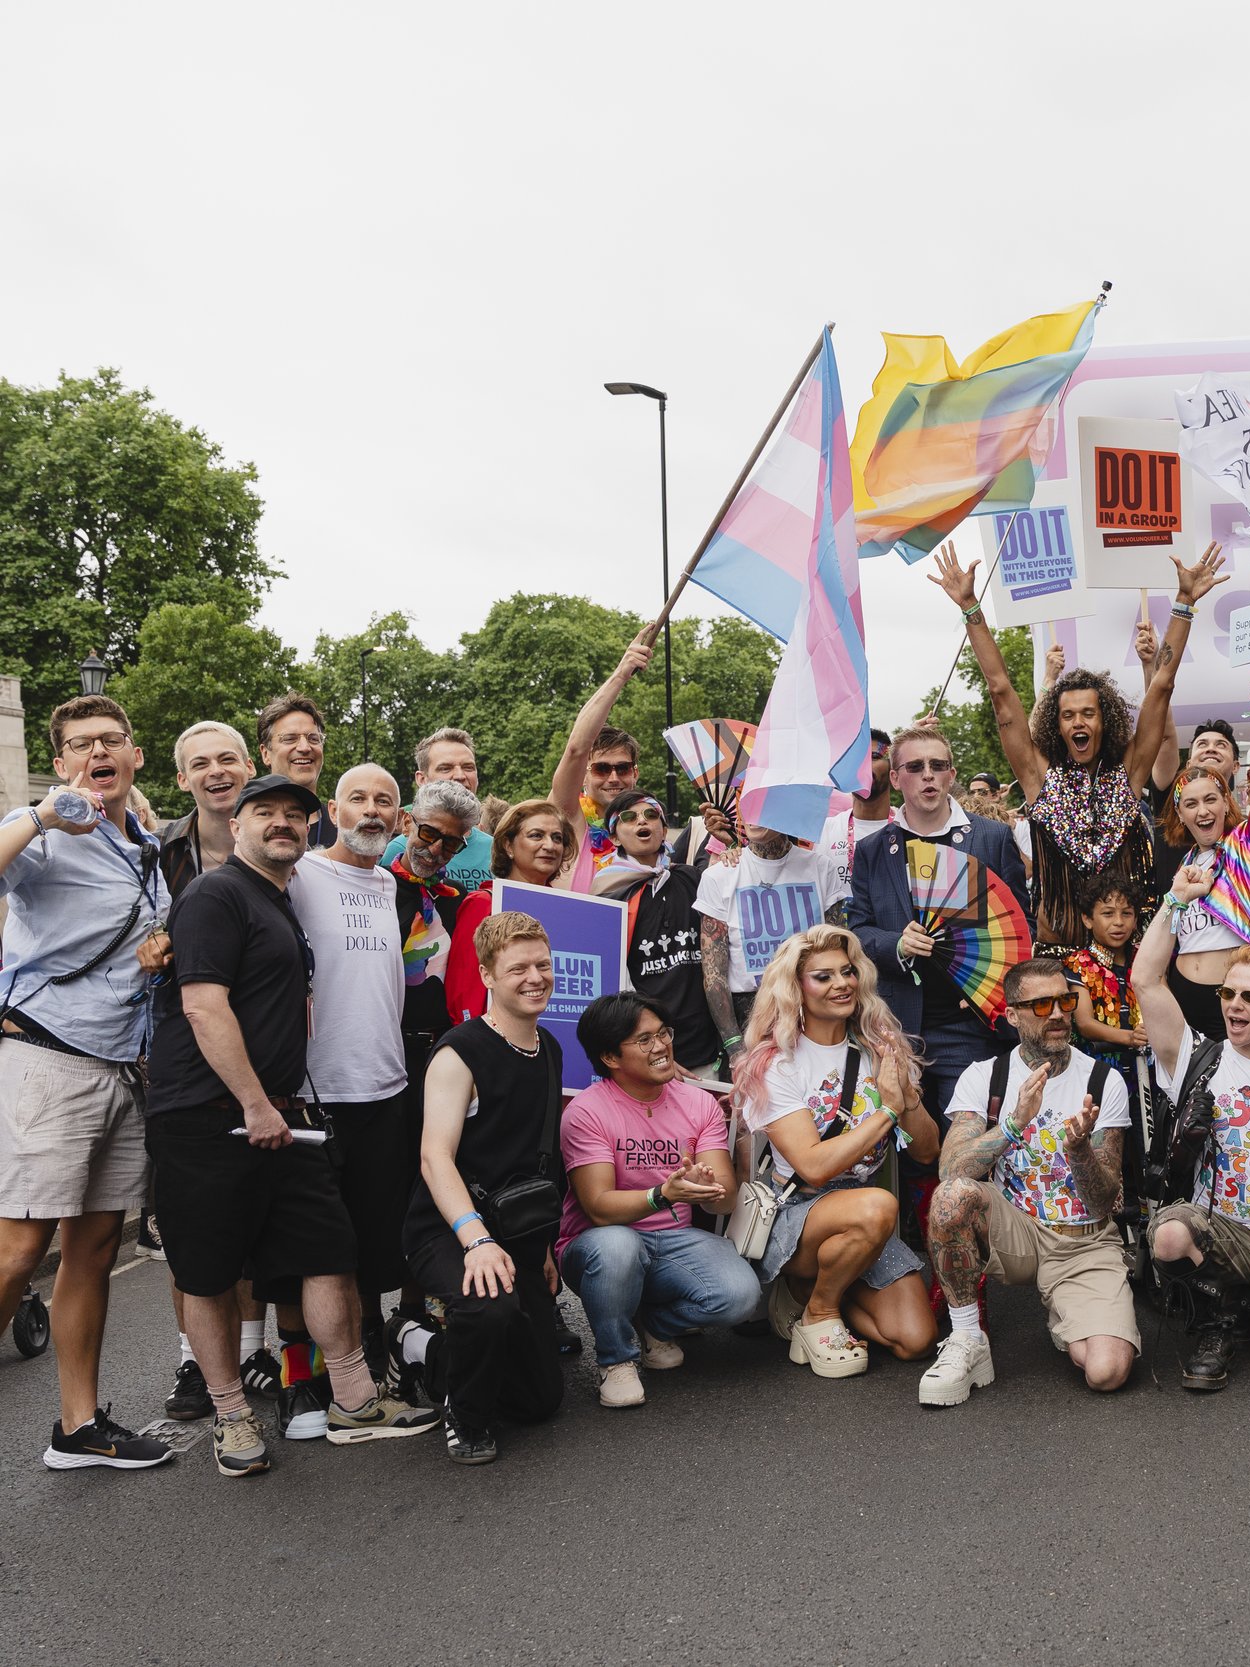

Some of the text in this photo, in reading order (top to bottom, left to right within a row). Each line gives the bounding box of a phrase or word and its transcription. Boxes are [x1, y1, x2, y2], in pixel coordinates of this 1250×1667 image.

[1098, 450, 1176, 513] DO IT
[1099, 512, 1178, 528] IN A GROUP
[996, 509, 1067, 562] DO IT
[1107, 535, 1169, 544] WWW.VOLUNQUEER.UK
[1003, 557, 1073, 571] WITH EVERYONE
[1004, 566, 1074, 583] IN THIS CITY
[1235, 632, 1248, 643] our
[1235, 643, 1247, 654] for
[444, 868, 493, 880] ONDON
[339, 892, 393, 912] PROTECT
[740, 885, 815, 940] DO IT
[343, 913, 372, 929] THE
[346, 935, 388, 952] DOLLS
[554, 956, 594, 978] LUN
[554, 976, 594, 997] EER
[616, 1138, 679, 1152] LONDON
[625, 1152, 681, 1166] FRIEND
